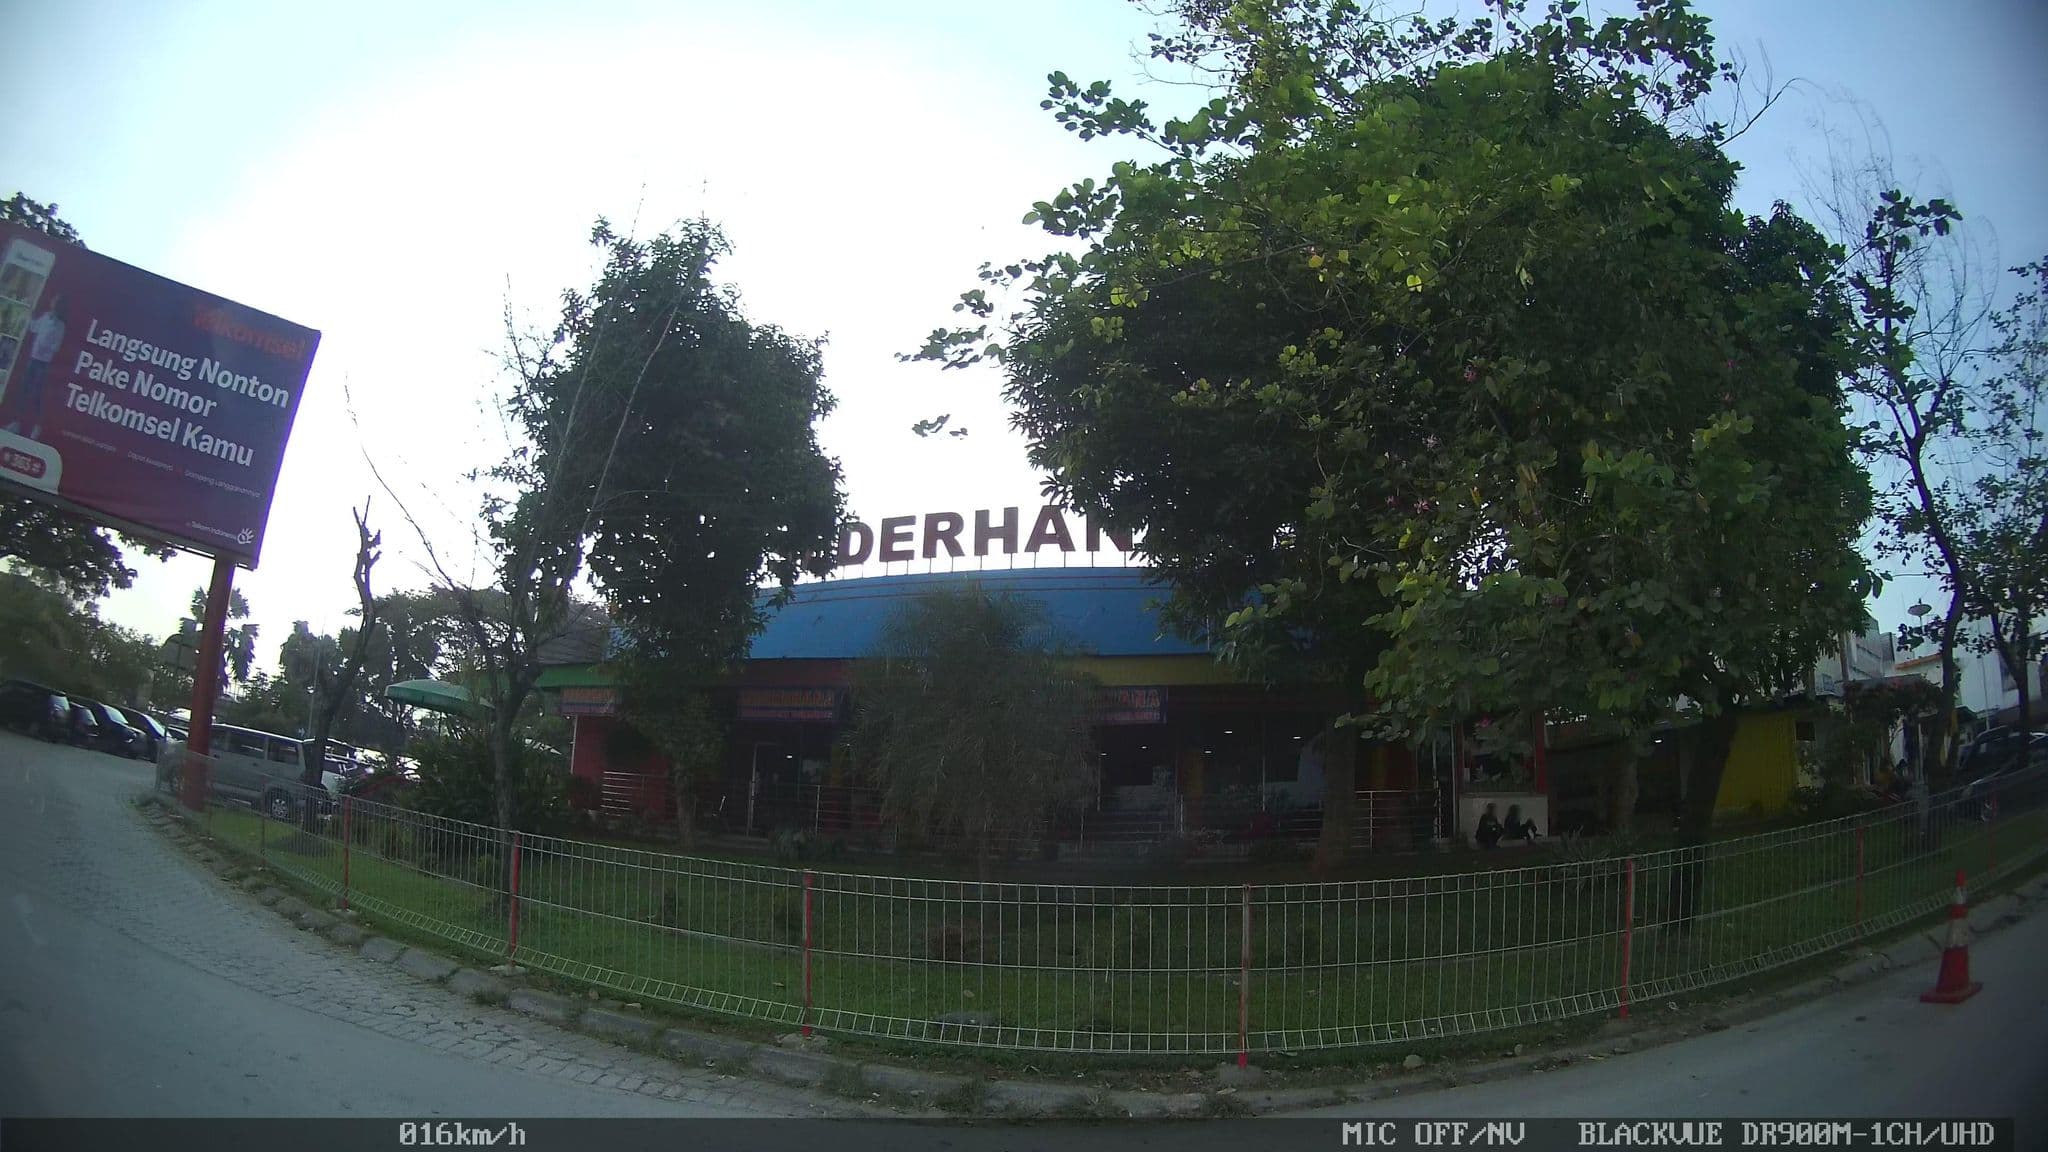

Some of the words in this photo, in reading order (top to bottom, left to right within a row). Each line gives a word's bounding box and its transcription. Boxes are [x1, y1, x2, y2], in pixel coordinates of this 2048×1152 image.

[74, 350, 129, 390] Pake
[132, 370, 218, 418] Nomor
[87, 318, 197, 381] Langsung
[199, 357, 290, 408] Nonton
[66, 382, 181, 442] Telkomsel
[183, 421, 254, 466] Kamu
[837, 504, 1133, 566] DERHAN
